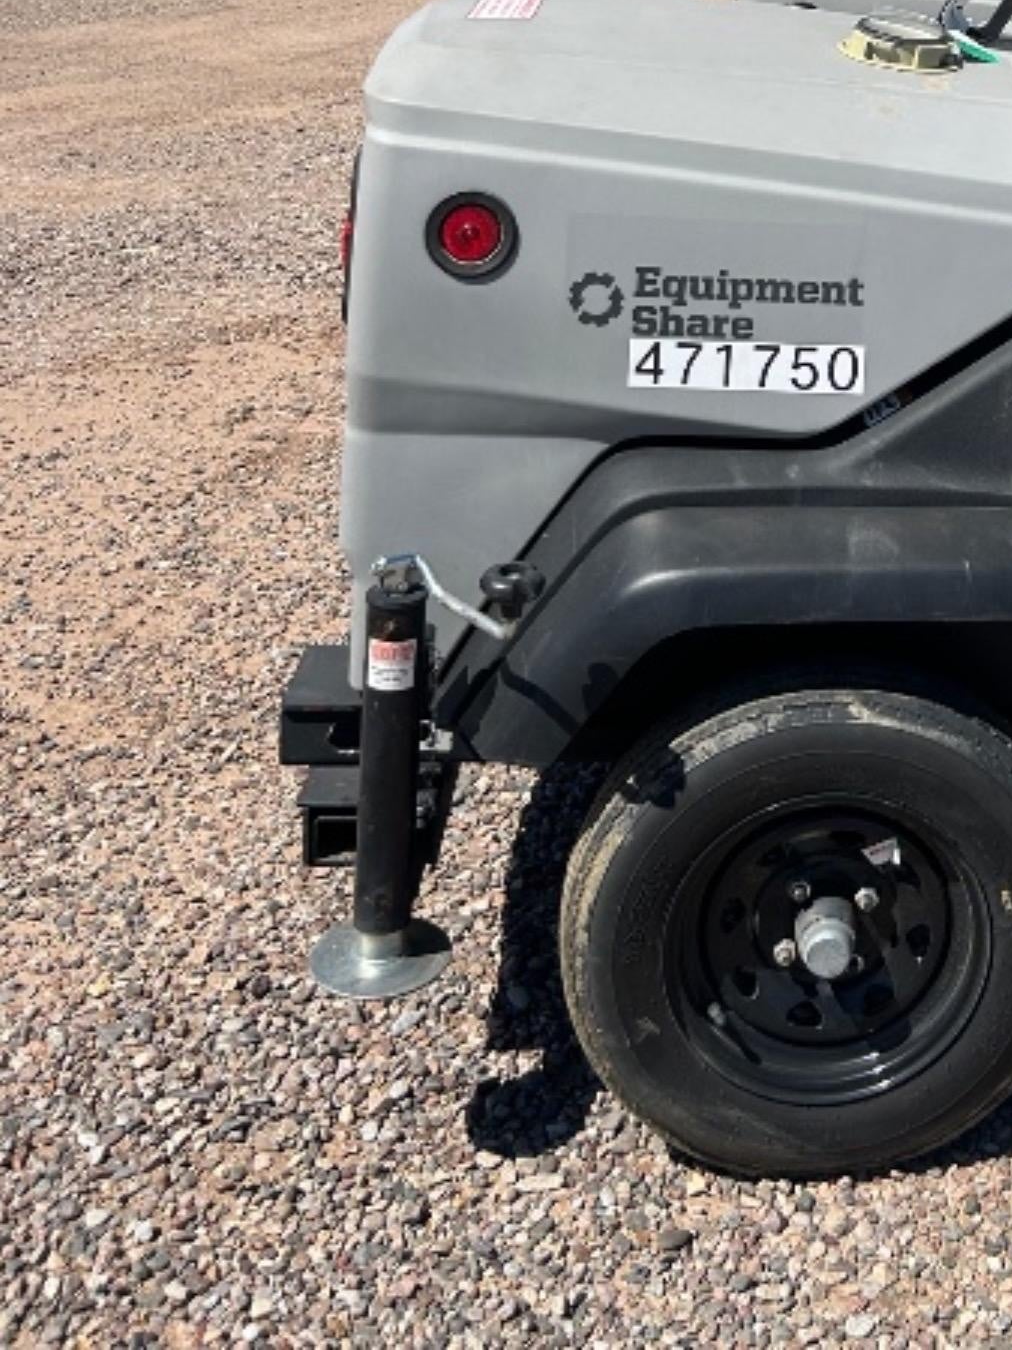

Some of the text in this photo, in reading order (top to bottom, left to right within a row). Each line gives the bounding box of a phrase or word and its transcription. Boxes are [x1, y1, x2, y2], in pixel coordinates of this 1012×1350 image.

[633, 266, 865, 309] Equipment
[631, 305, 754, 339] Share
[634, 341, 860, 391] 471750
